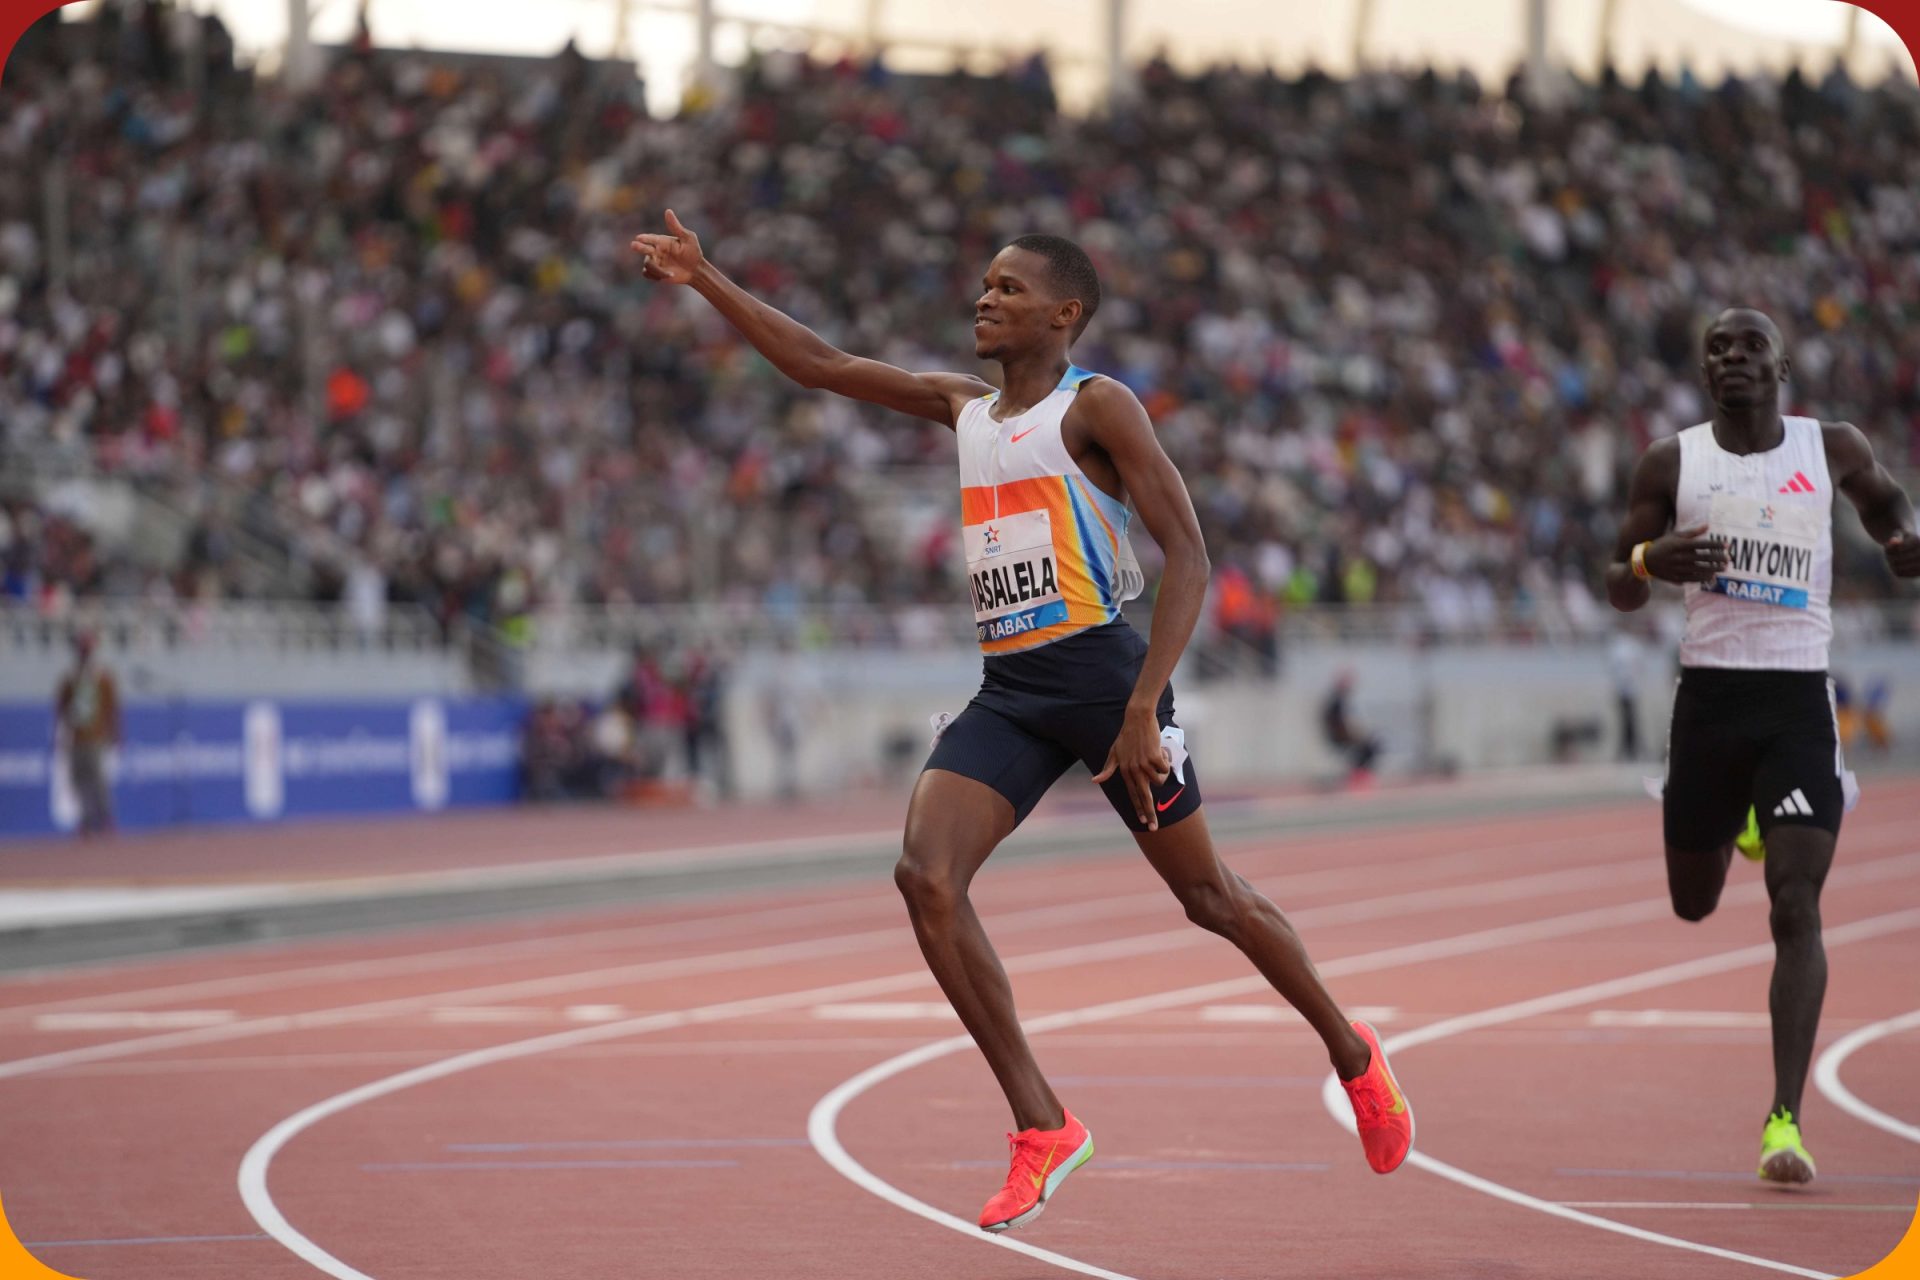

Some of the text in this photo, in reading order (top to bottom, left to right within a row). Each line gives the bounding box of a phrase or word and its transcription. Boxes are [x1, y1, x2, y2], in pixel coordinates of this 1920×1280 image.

[985, 545, 1002, 556] SNRT
[1726, 580, 1784, 604] RABAT
[989, 613, 1036, 641] RABAT
